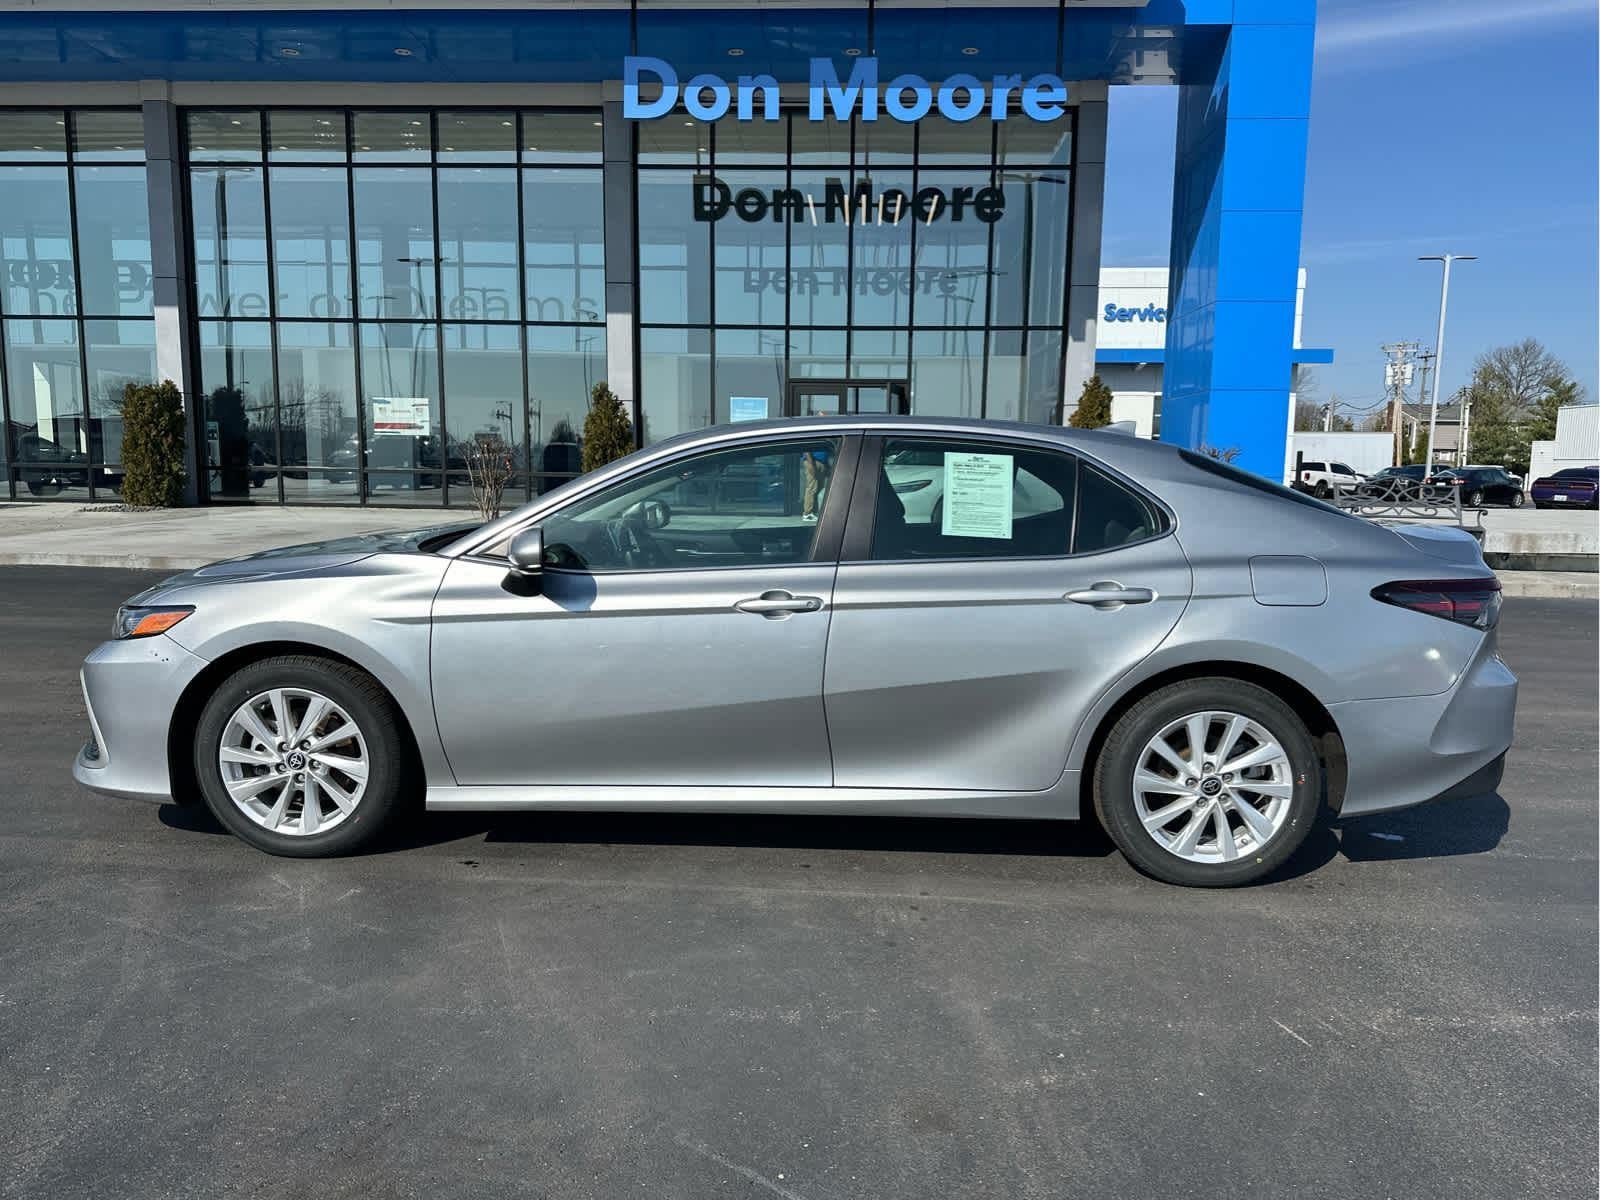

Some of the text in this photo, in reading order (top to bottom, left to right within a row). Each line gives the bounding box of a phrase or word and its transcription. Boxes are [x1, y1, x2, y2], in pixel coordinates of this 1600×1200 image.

[623, 55, 1068, 124] Don Moore
[693, 174, 1006, 224] Don Moore
[1104, 302, 1167, 323] Servic
